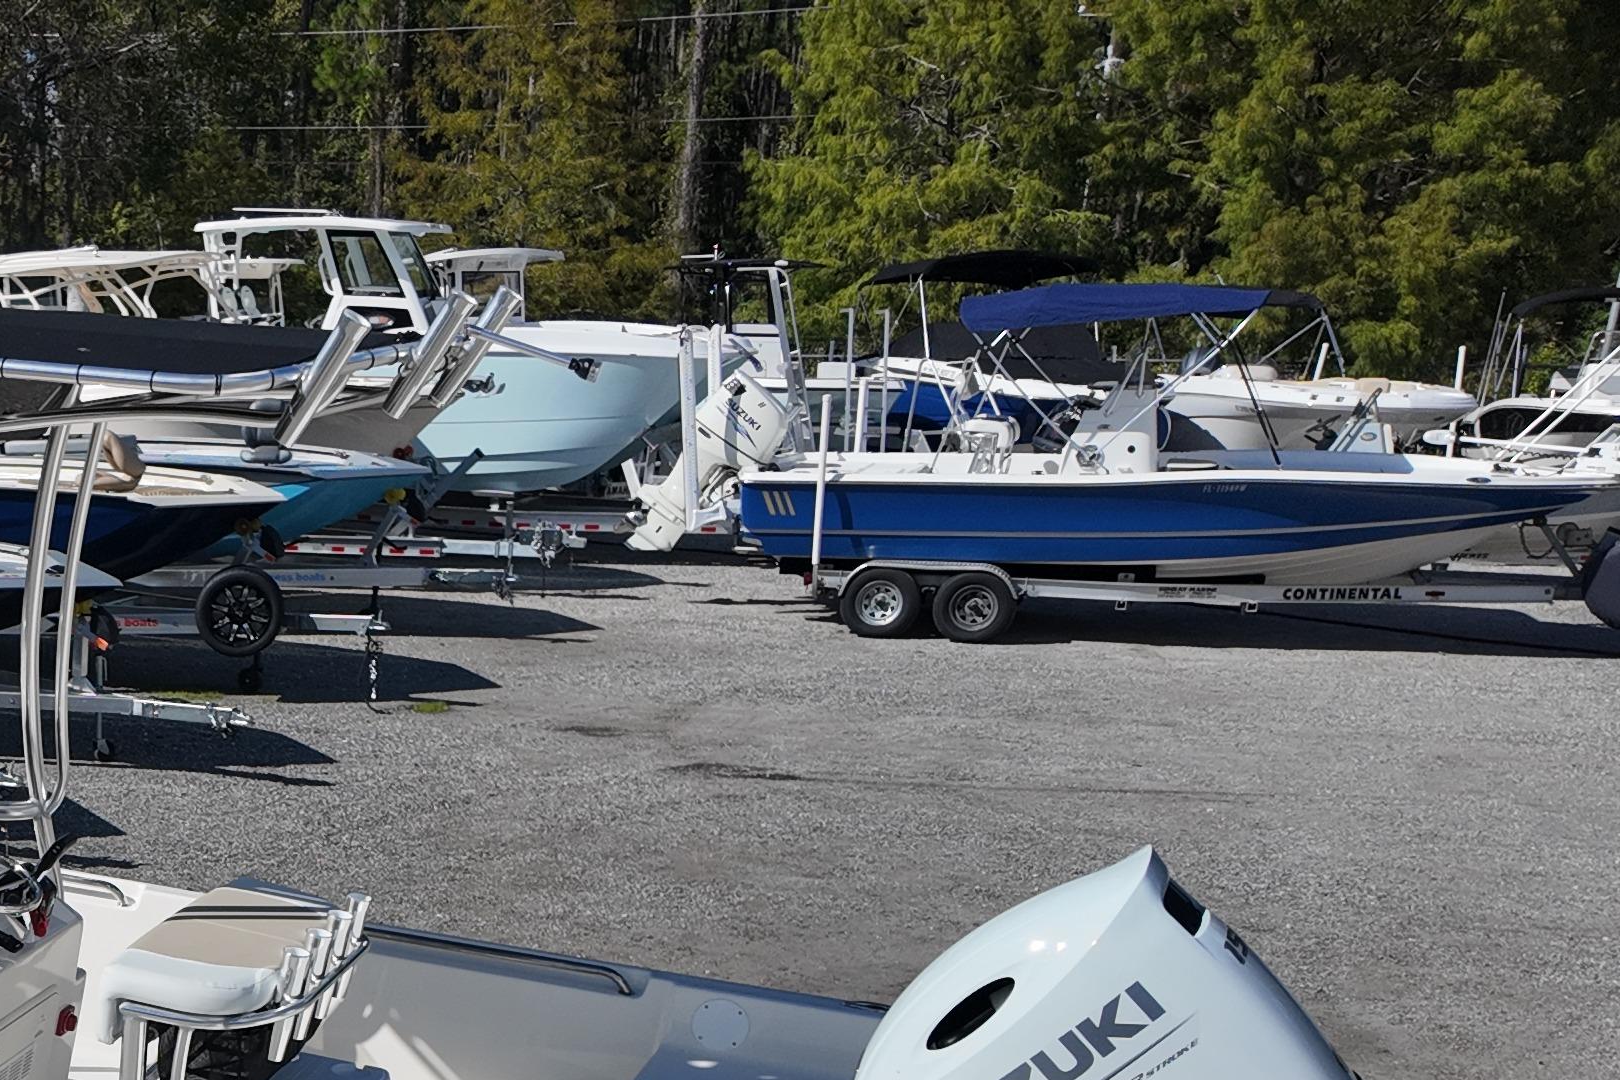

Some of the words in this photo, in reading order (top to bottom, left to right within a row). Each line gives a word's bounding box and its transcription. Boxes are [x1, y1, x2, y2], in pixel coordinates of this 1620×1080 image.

[727, 397, 761, 431] SUZUKI
[1282, 587, 1403, 600] CONTINENTAL
[1224, 926, 1249, 965] 15
[1144, 1037, 1199, 1079] STROKE
